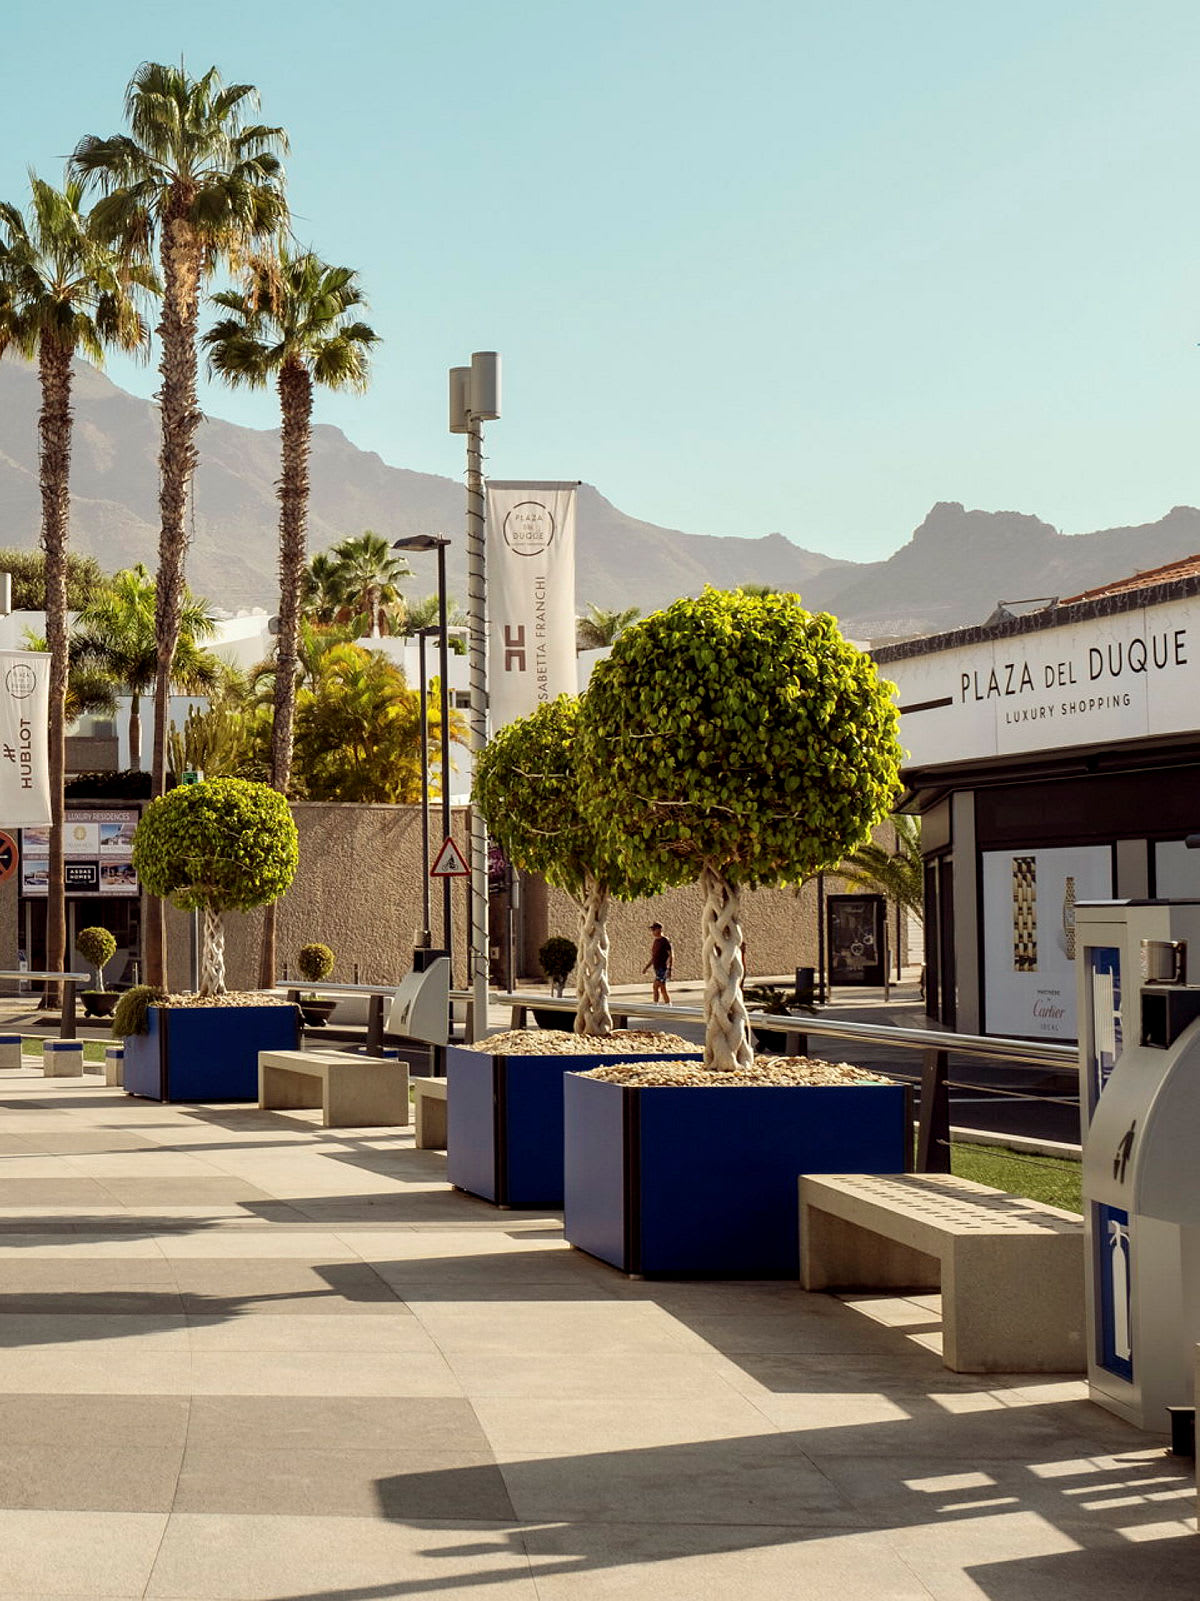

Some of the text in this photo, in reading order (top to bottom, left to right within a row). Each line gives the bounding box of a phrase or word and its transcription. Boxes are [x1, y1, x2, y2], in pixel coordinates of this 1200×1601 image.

[515, 513, 544, 521] PLAZA
[512, 531, 544, 540] DUQUE
[535, 576, 549, 702] SABETTA FRANCHI
[962, 630, 1187, 703] PLAZA DEL DUQUE
[1005, 693, 1131, 724] LUXURY SHOPPING
[20, 718, 32, 789] HUBLOT
[68, 812, 130, 821] LUXURY RESIDENCES
[1033, 1000, 1066, 1019] Cartier
